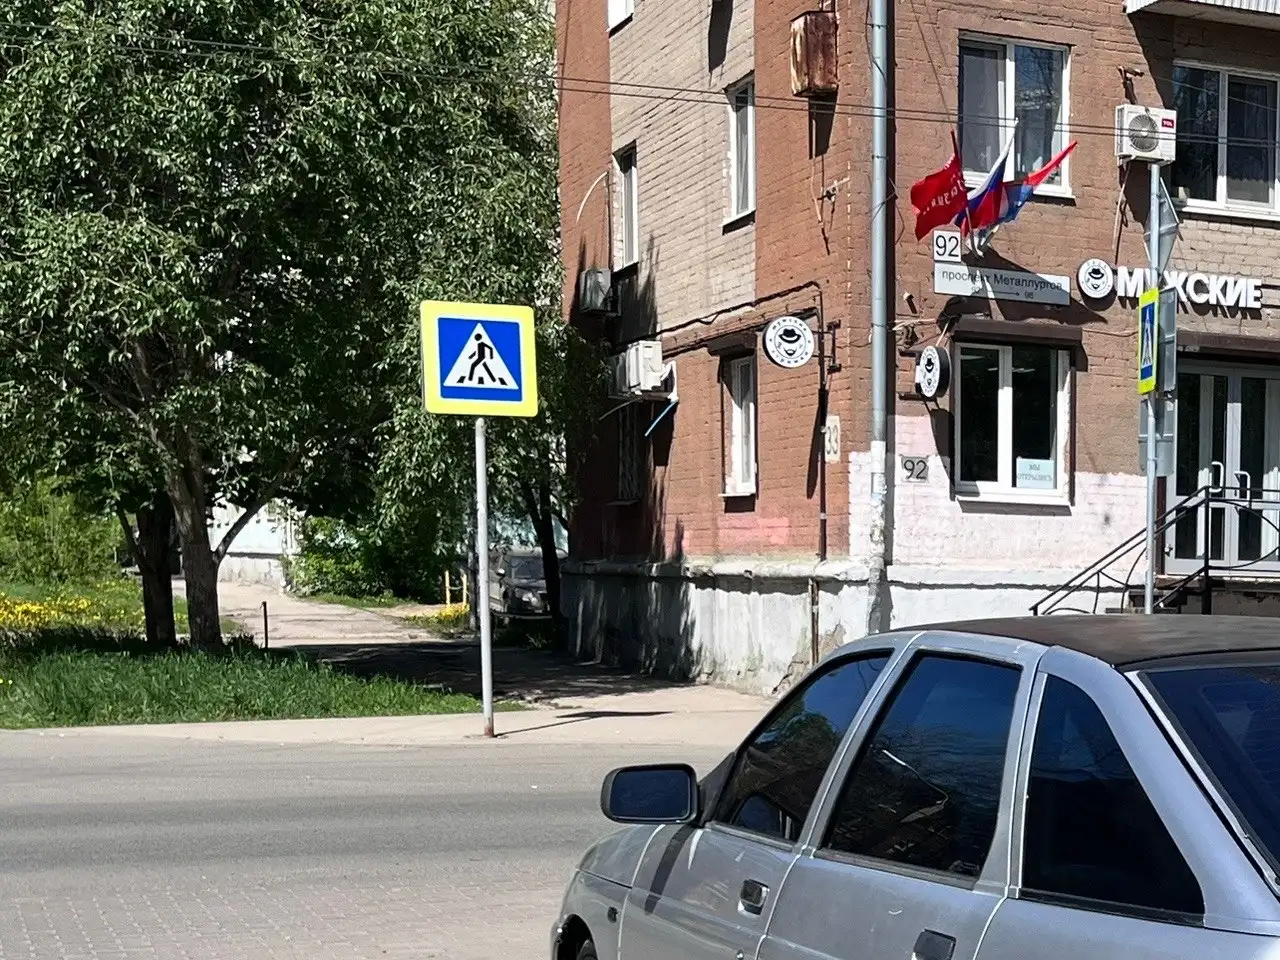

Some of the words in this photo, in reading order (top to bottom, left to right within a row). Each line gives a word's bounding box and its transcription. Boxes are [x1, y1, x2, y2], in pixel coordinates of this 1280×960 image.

[935, 235, 959, 257] 92
[942, 270, 990, 283] проспект
[994, 274, 1063, 291] Металлургов
[903, 459, 927, 480] 92
